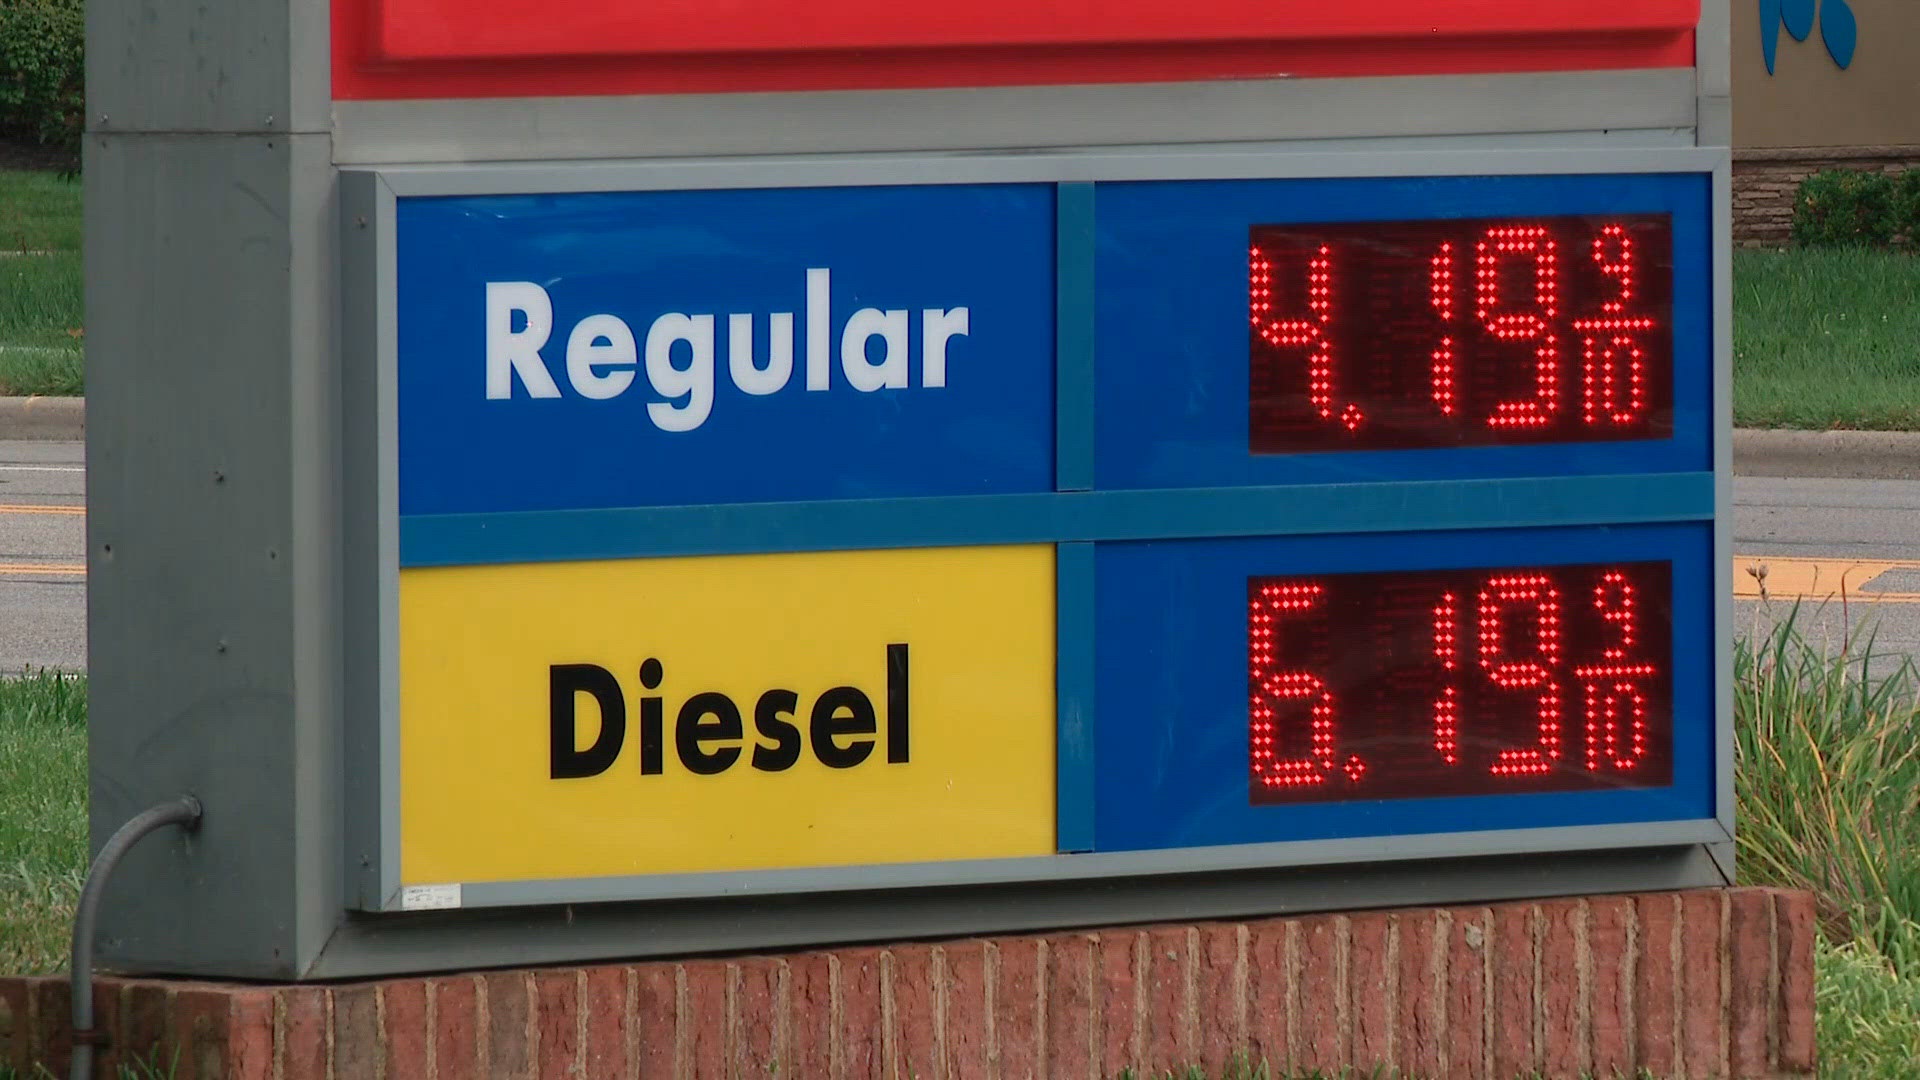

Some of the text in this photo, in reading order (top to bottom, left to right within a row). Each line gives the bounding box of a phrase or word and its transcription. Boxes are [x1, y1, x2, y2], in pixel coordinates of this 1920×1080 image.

[486, 267, 969, 432] Regular
[1250, 227, 1559, 430] 4.19
[549, 643, 910, 780] Diesel
[1250, 574, 1561, 786] 6.19
